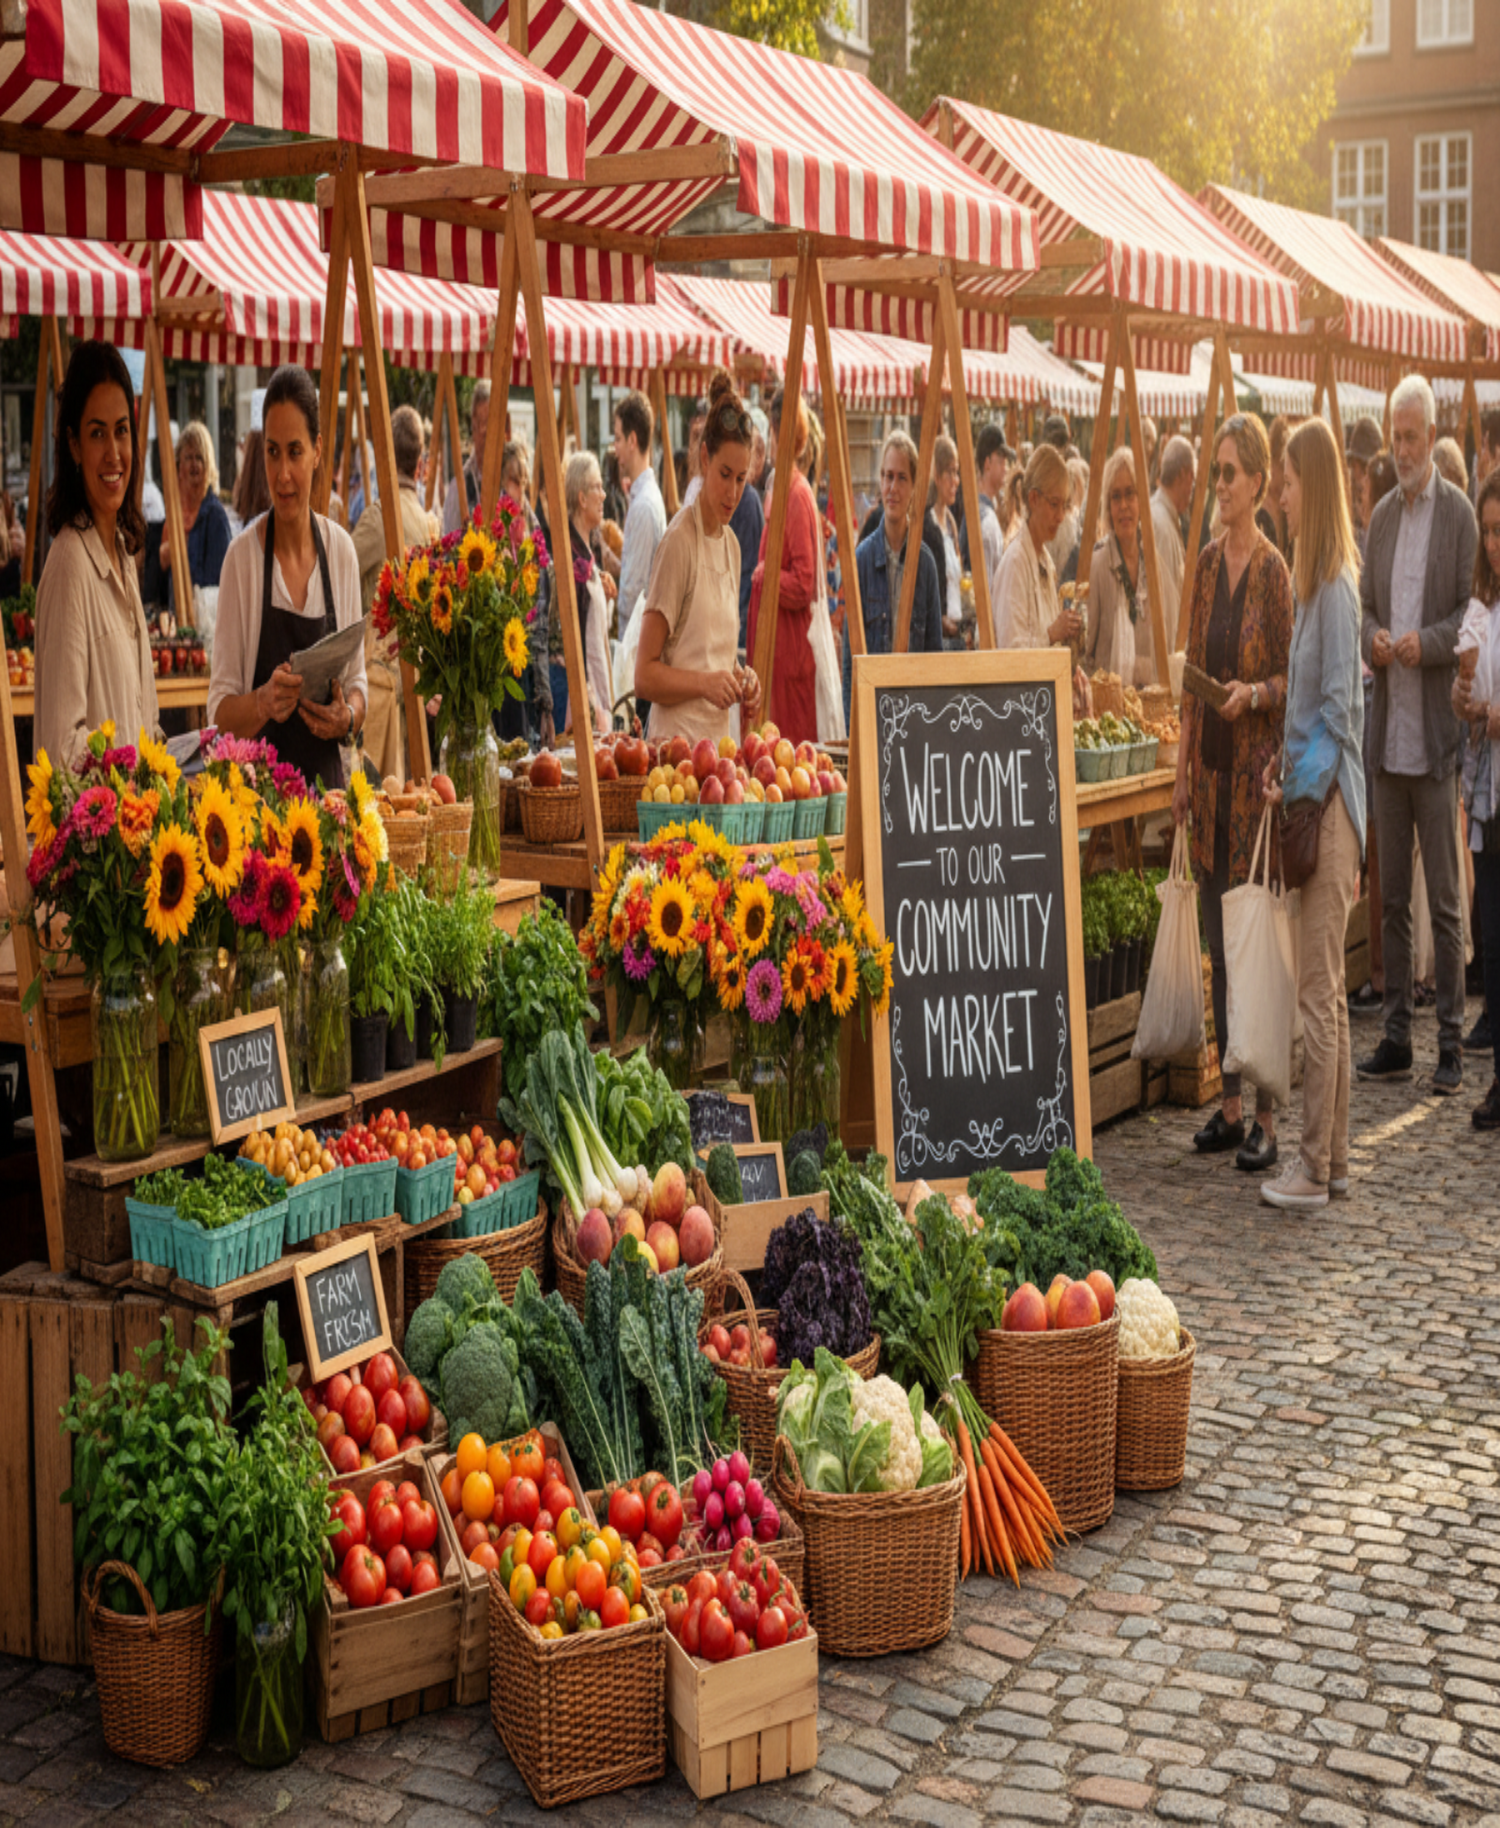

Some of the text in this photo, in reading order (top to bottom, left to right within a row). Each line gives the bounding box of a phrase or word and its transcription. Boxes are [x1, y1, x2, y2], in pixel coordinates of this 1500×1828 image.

[900, 743, 1035, 834] WELCOME
[936, 843, 1006, 886] TO OUR
[897, 893, 1053, 977] COMMUNITY
[215, 1032, 273, 1082] LOCALLY
[924, 990, 1038, 1084] MARKET
[316, 1266, 362, 1314] FARM
